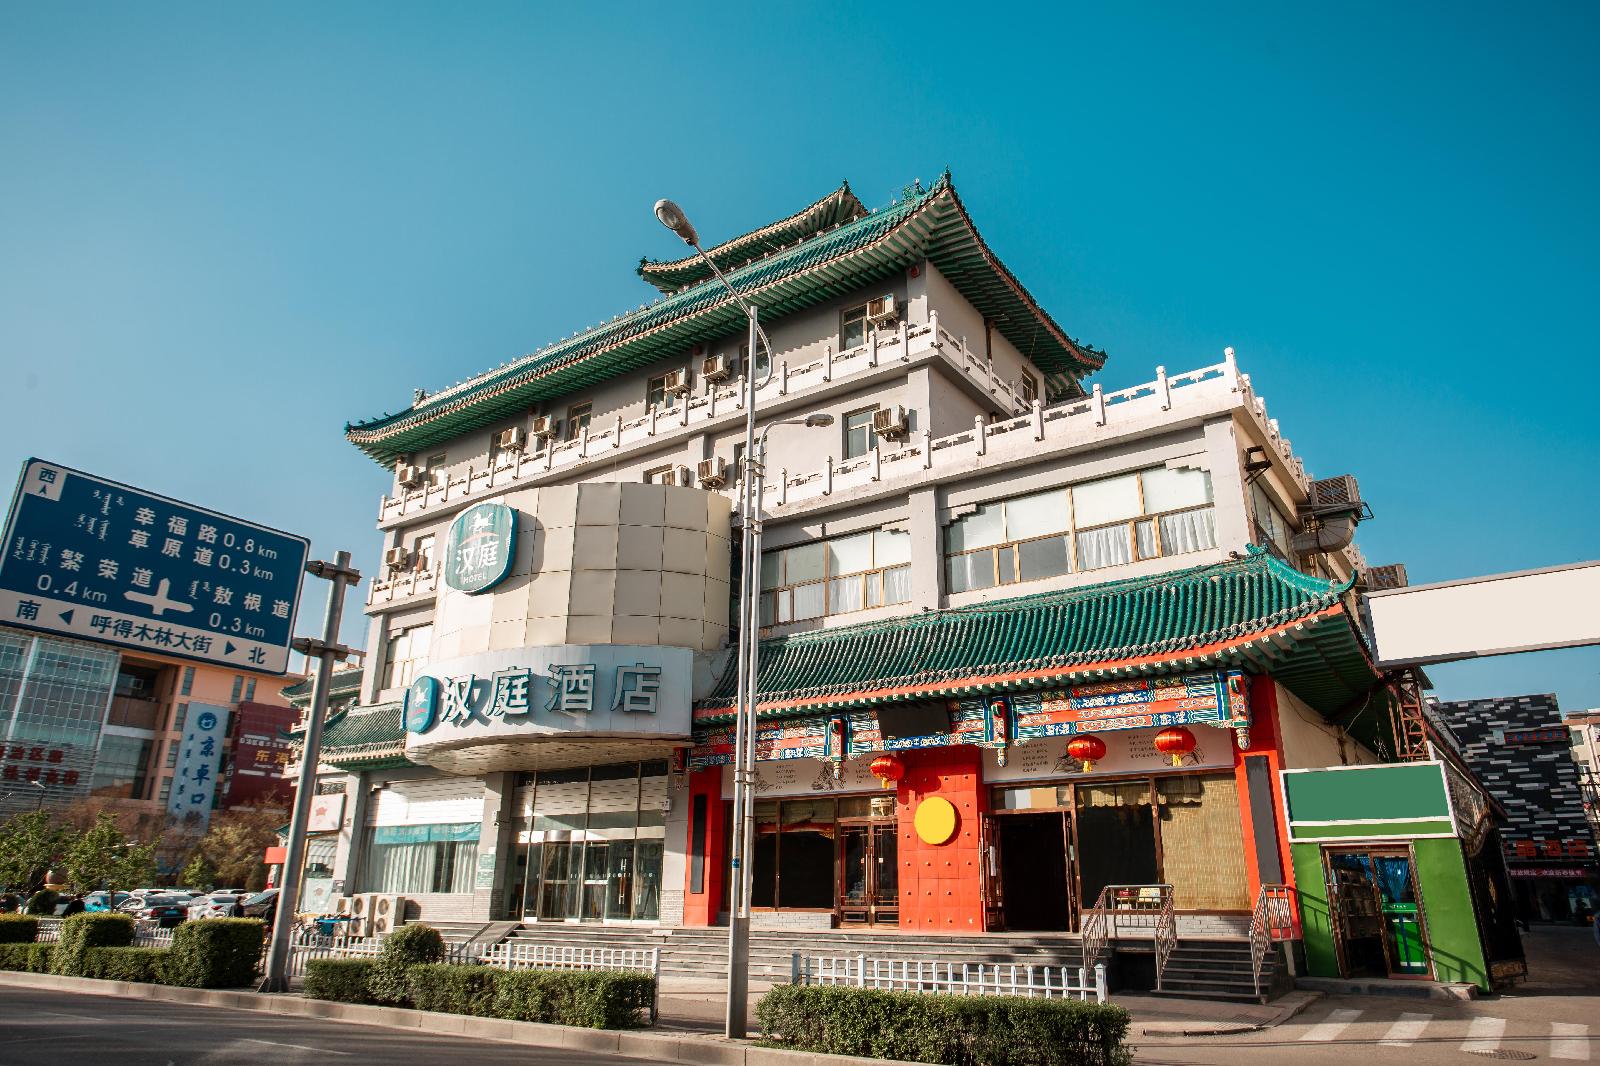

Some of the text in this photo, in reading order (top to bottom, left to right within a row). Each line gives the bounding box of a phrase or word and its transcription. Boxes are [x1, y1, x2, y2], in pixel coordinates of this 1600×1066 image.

[39, 467, 58, 484] 西
[134, 507, 218, 544] 幸福路
[127, 529, 214, 567] 草原道
[455, 540, 500, 575] 汉庭
[60, 549, 154, 588] 繁荣道
[463, 573, 487, 584] HOTEL
[213, 586, 291, 619] 敖根道
[15, 600, 267, 665] 南 呼得木林大街 北
[440, 662, 662, 724] 汉庭酒店
